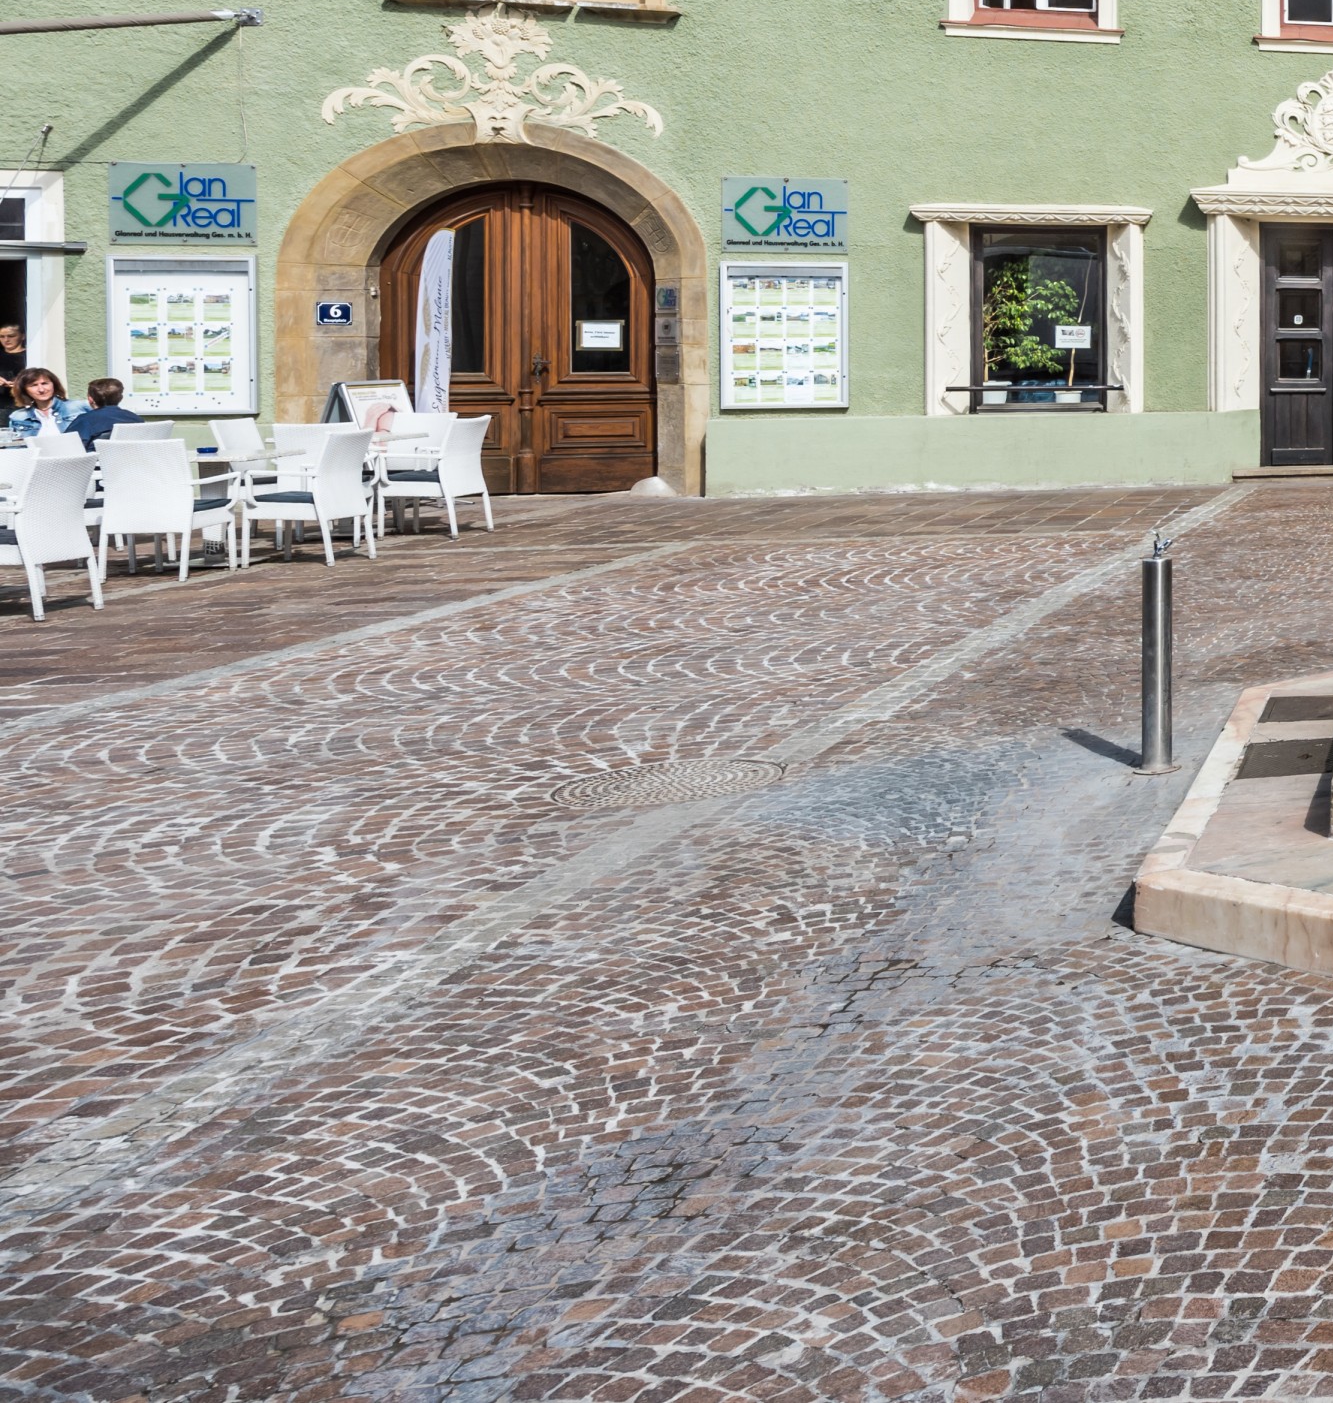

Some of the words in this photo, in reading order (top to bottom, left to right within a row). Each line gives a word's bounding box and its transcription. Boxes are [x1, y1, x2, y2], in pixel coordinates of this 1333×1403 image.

[172, 200, 241, 228] Real
[776, 212, 835, 237] Real
[159, 231, 210, 240] Hausverwaltung
[329, 304, 342, 318] 6
